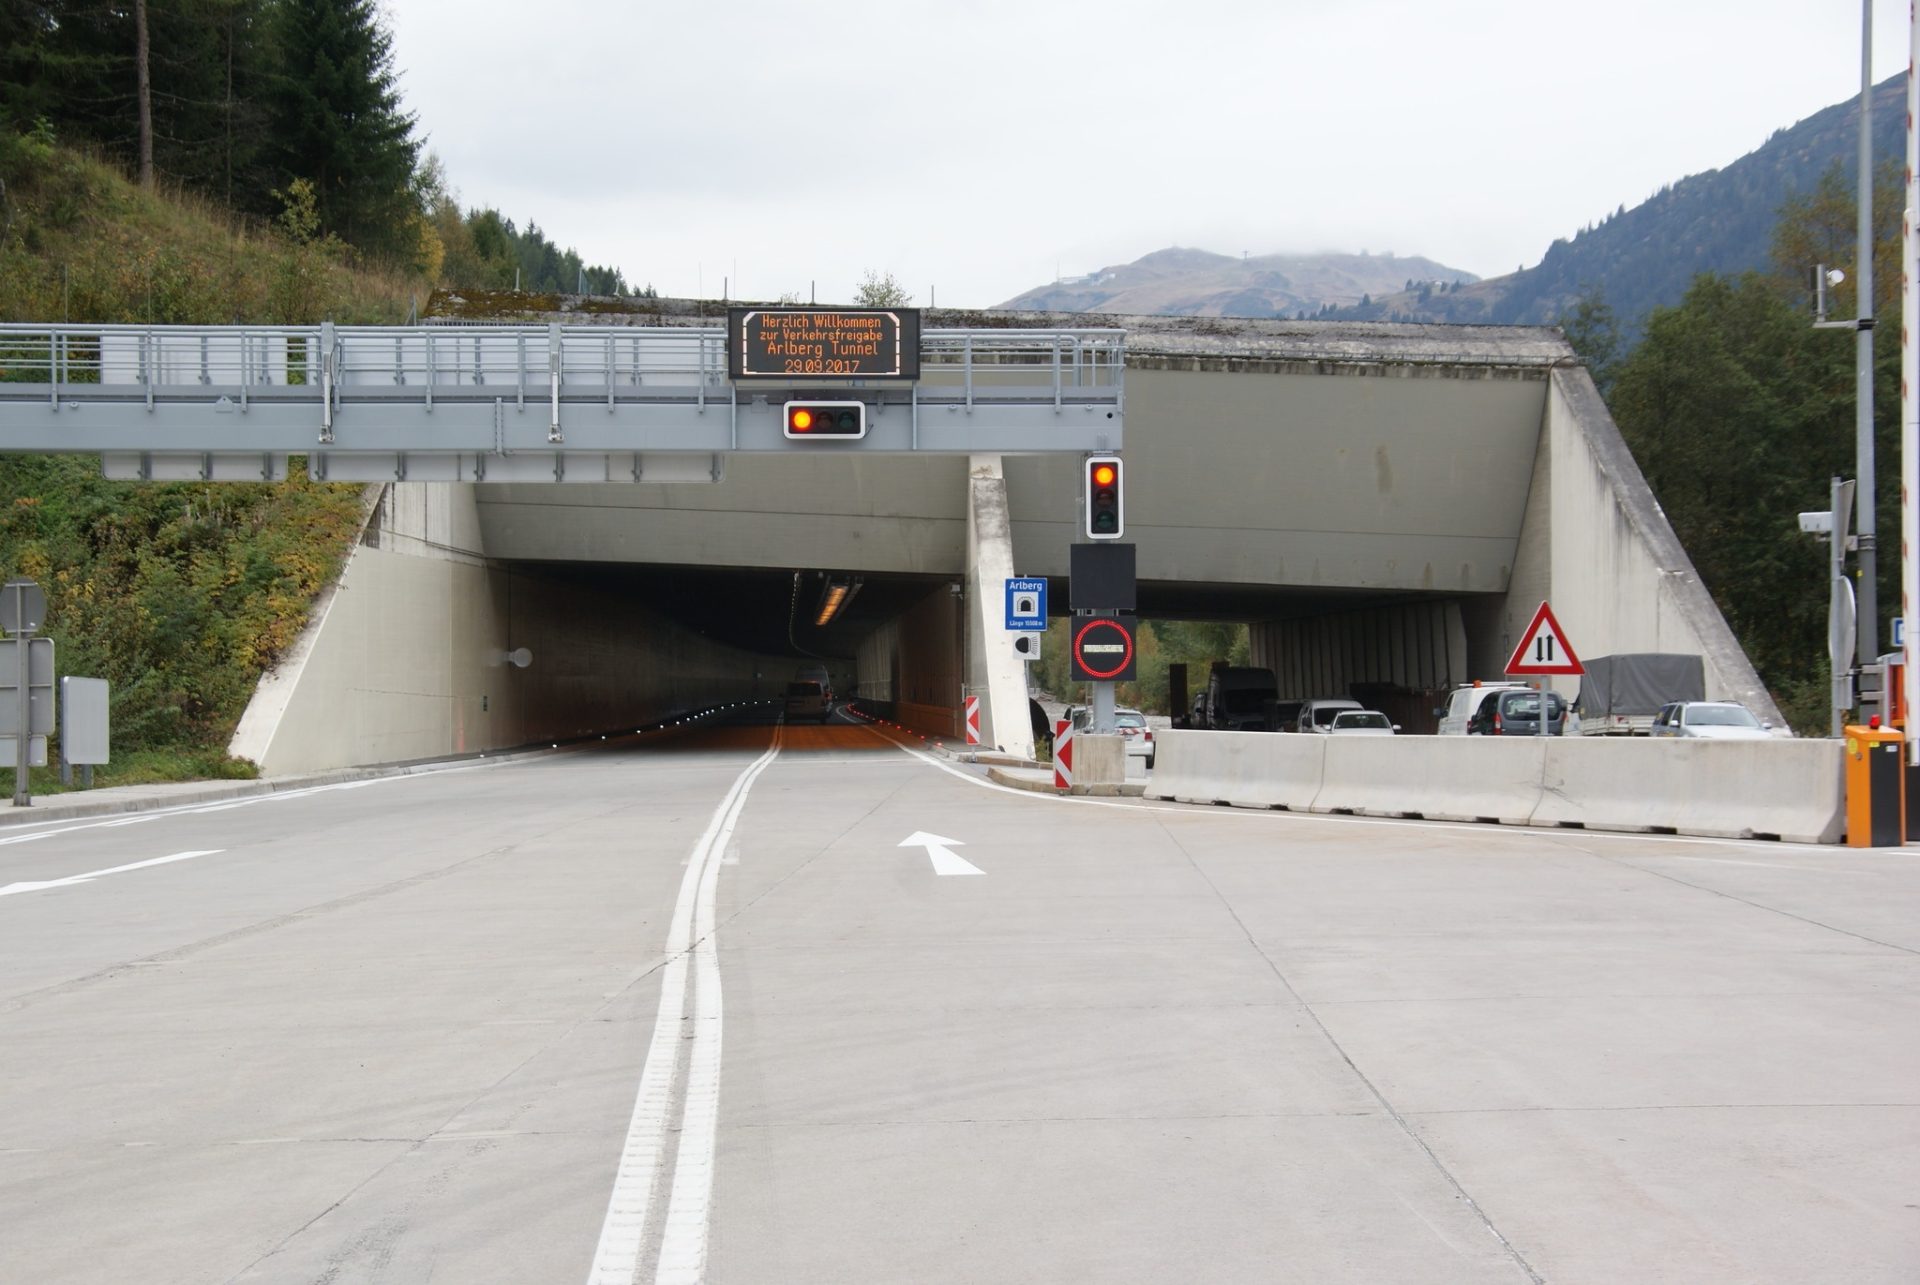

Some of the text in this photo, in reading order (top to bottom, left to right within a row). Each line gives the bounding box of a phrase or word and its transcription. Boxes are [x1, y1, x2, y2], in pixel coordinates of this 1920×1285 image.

[762, 314, 881, 327] Herzlich Willkommen
[760, 329, 883, 343] zur Verkehrsfreigabe
[767, 341, 878, 358] Arlberg Tunnel
[785, 359, 860, 373] 29.09.2017
[1009, 581, 1043, 591] Arlberg
